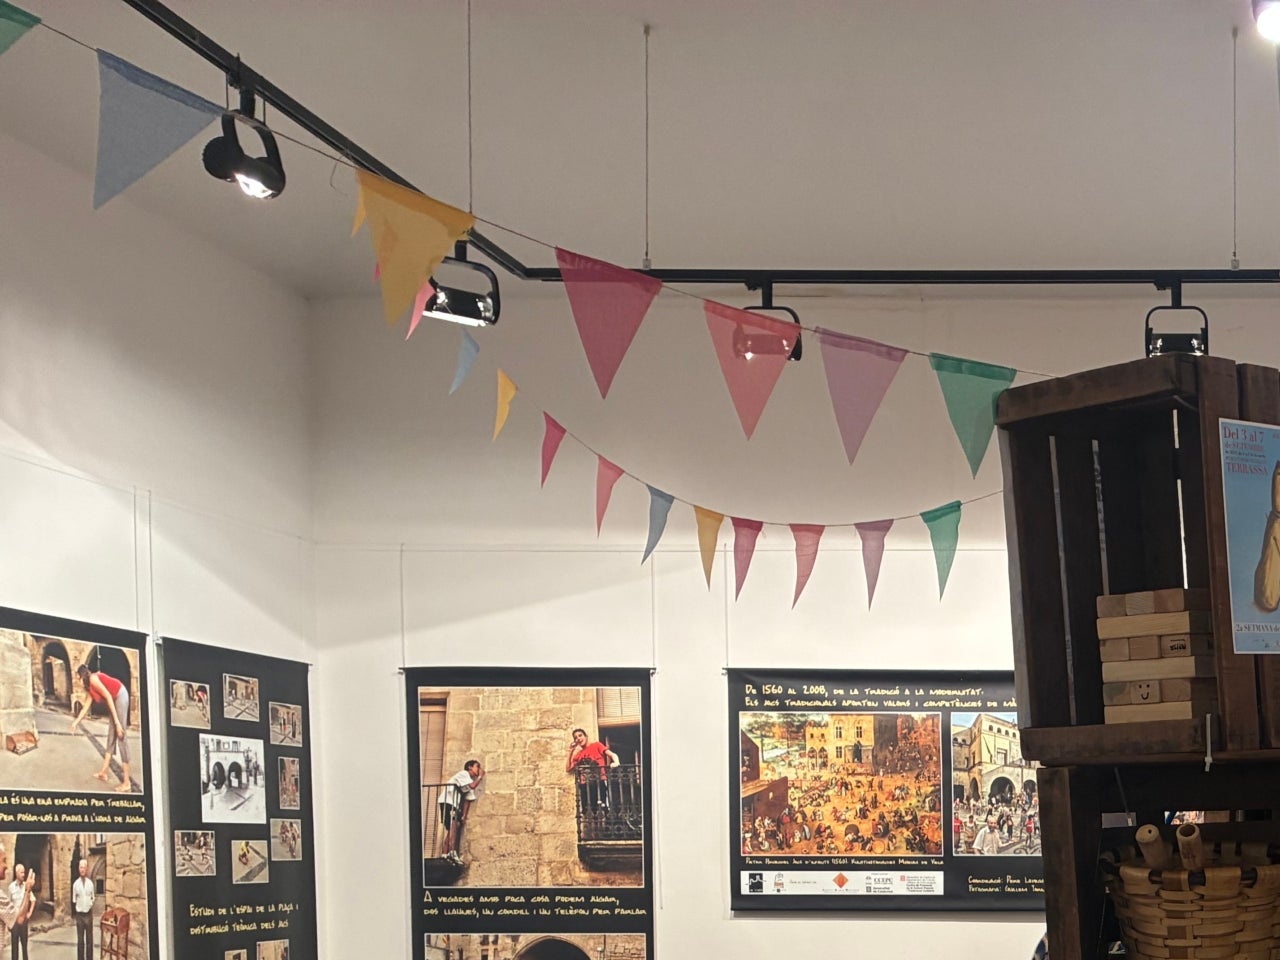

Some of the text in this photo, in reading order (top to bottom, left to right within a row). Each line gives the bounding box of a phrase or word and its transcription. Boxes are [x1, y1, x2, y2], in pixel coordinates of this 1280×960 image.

[1224, 426, 1239, 440] Del
[762, 684, 783, 694] 1560
[802, 685, 829, 697] 2008,
